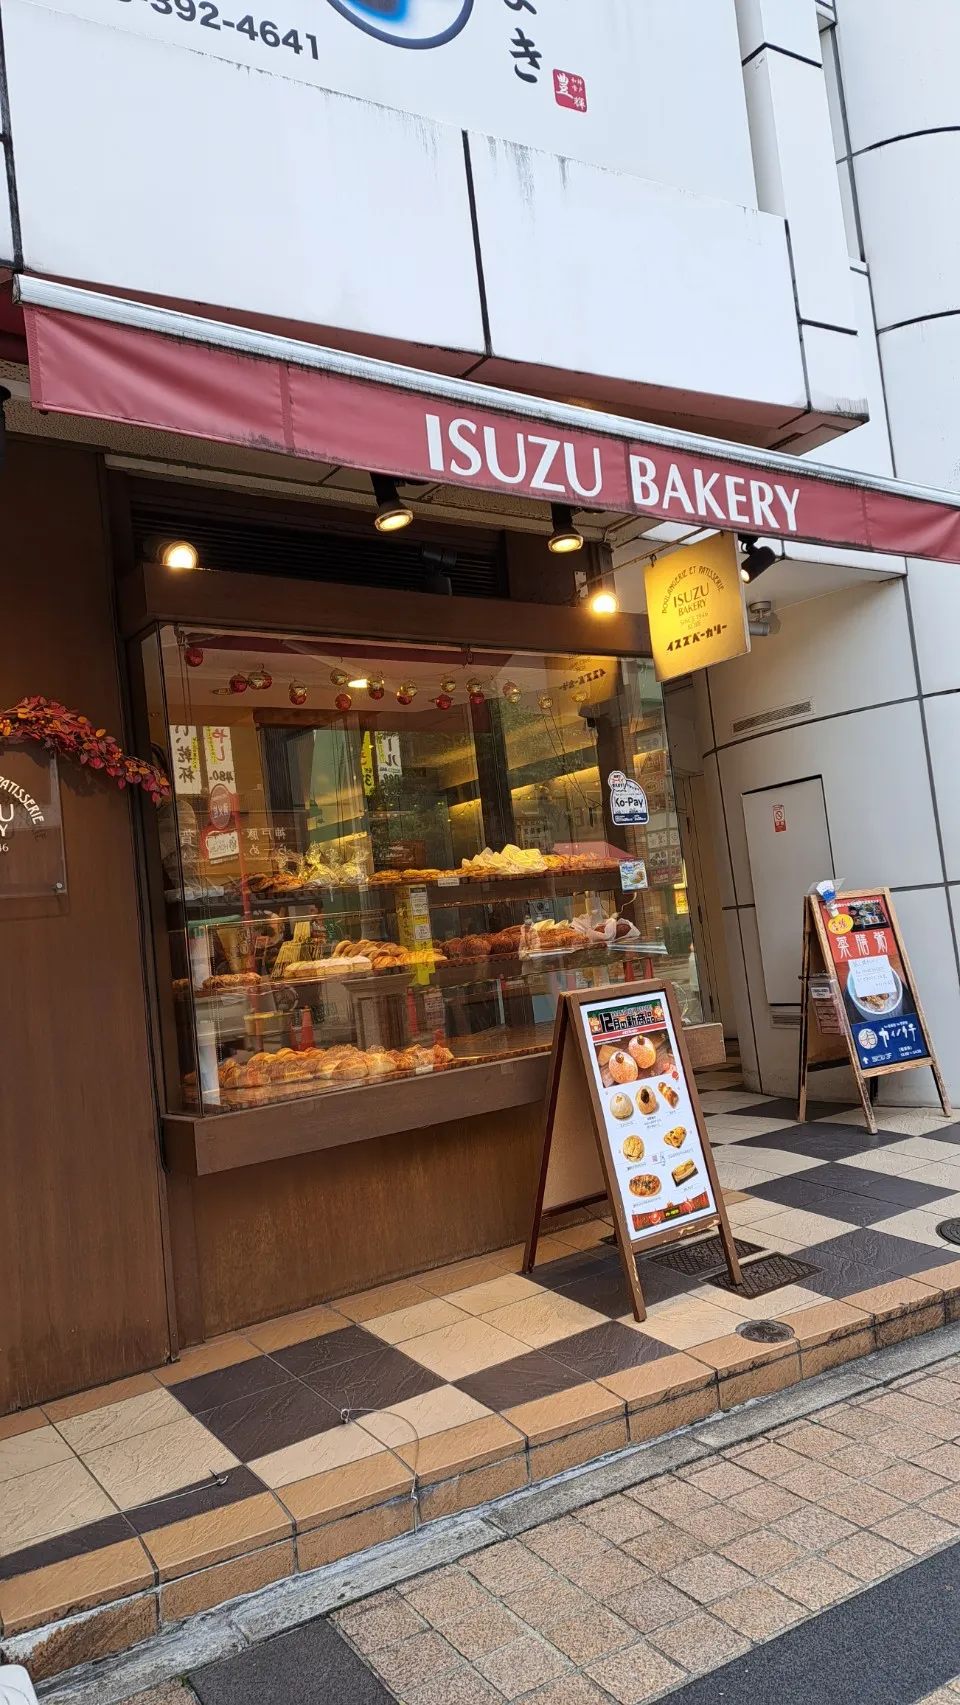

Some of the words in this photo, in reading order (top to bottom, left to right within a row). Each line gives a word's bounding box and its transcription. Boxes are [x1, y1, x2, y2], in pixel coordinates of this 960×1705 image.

[425, 413, 603, 498] ISUZU
[630, 454, 800, 531] BAKERY
[688, 565, 697, 576] ET
[673, 582, 711, 609] ISUZU
[678, 598, 708, 617] BAKERY
[666, 623, 728, 652] イスズベーカリー
[614, 796, 644, 808] Ko-Pay
[836, 931, 888, 959] 薬膳粥
[599, 1011, 656, 1033] 12月の新商品
